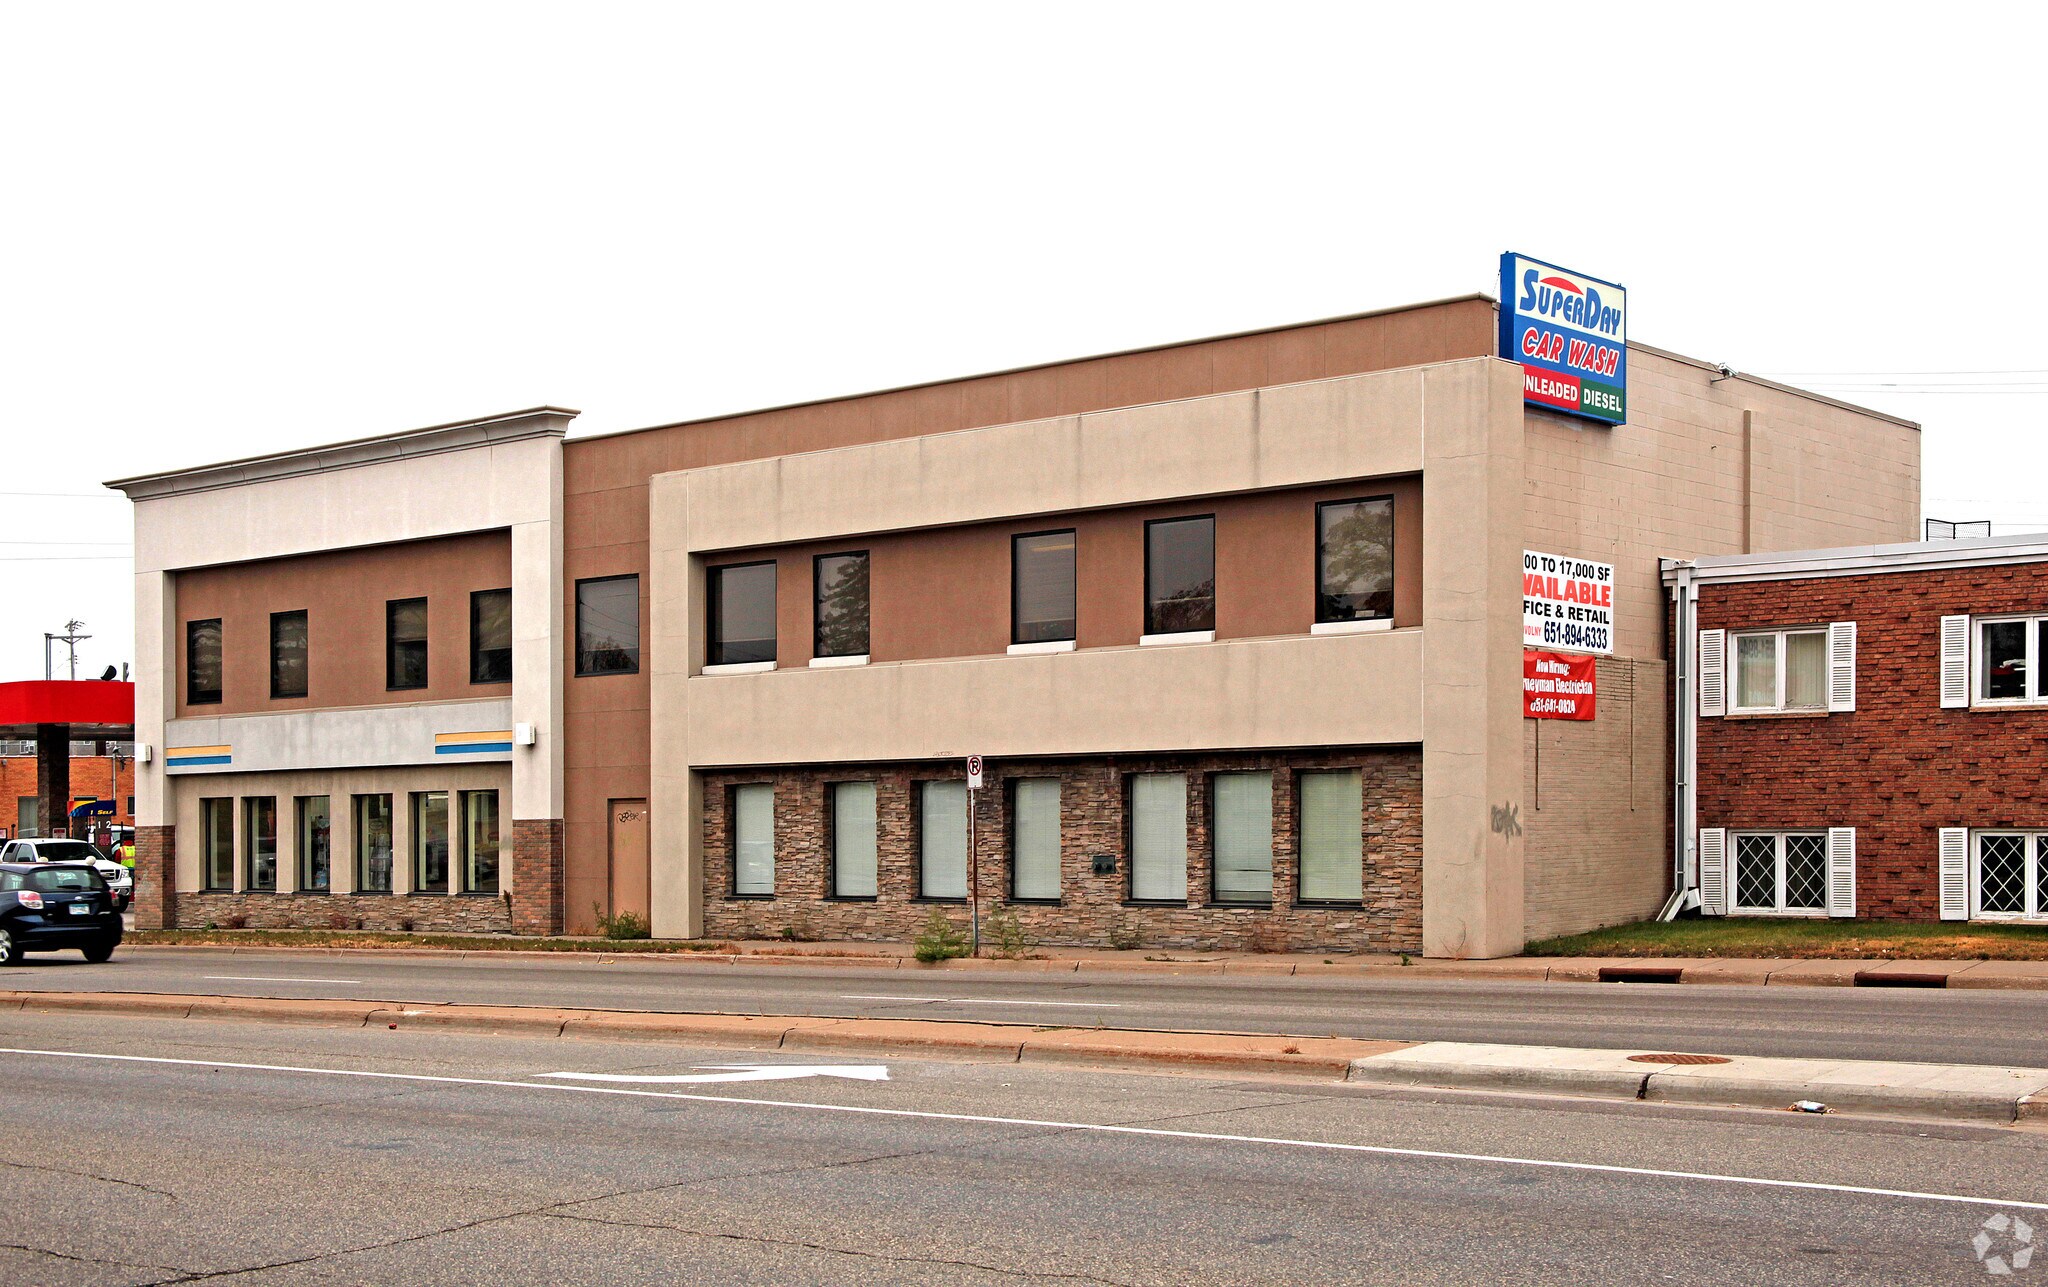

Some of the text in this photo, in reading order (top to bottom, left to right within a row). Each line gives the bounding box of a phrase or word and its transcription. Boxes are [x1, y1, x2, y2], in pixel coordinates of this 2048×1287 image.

[1522, 327, 1620, 377] CAR WASH
[1583, 388, 1622, 412] DIESEL
[1540, 556, 1556, 573] TO
[1559, 560, 1595, 579] 17,000
[1597, 566, 1610, 581] SF
[1523, 600, 1610, 625] FICE & RETAIL
[1544, 620, 1607, 649] 651-894-6333
[1535, 658, 1548, 673] Now
[1555, 677, 1593, 695] Electrician
